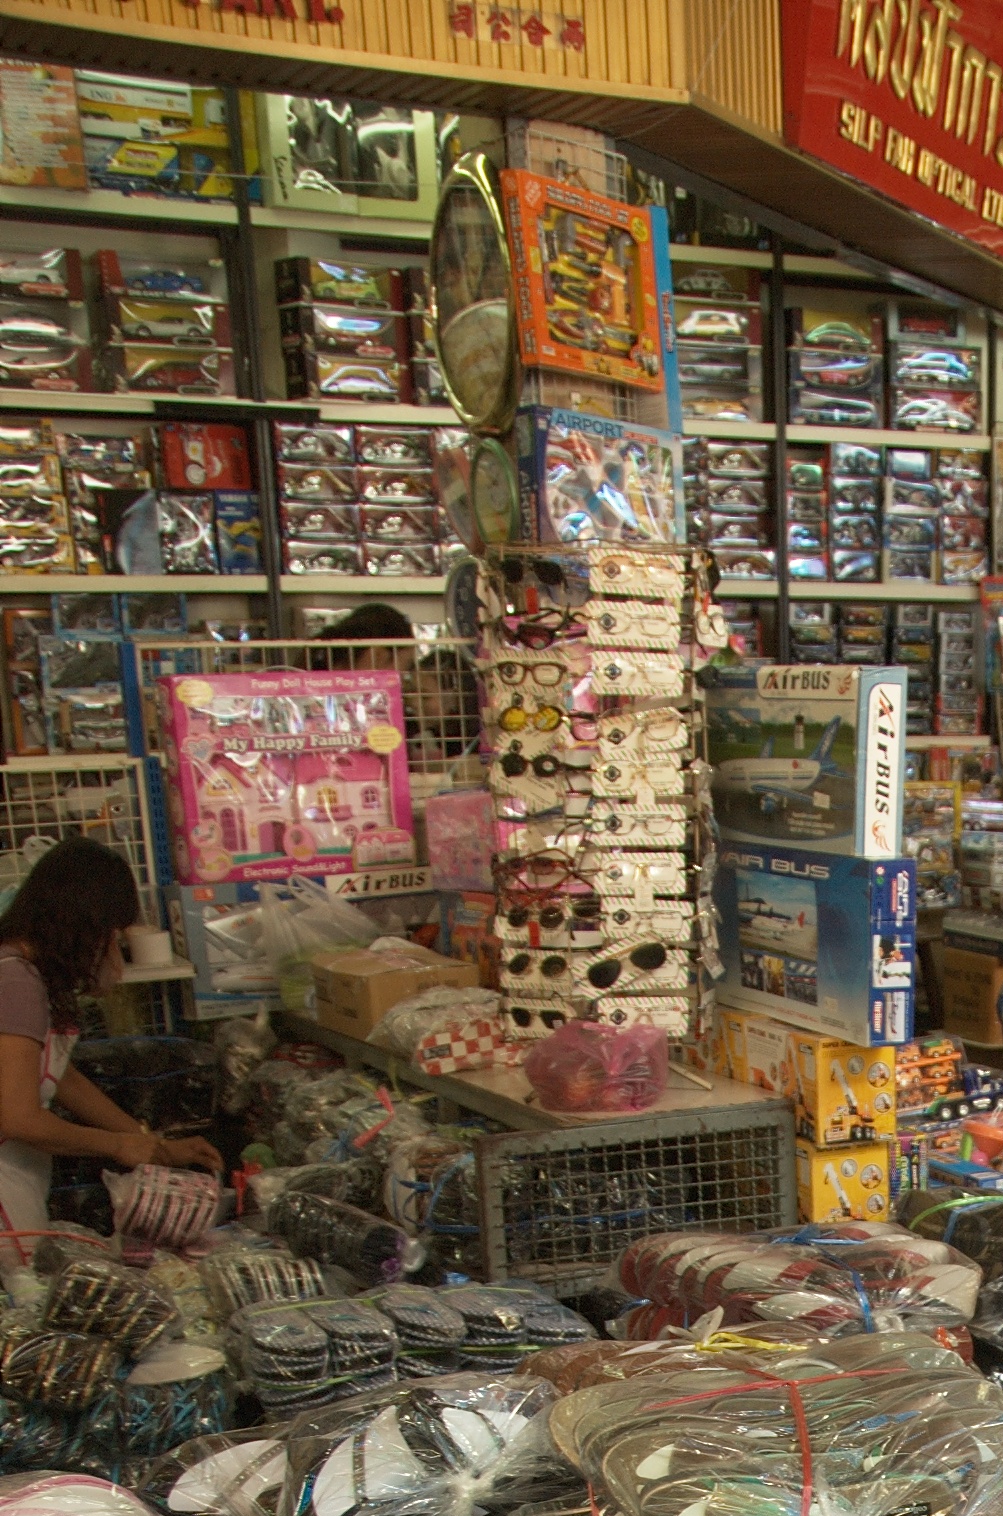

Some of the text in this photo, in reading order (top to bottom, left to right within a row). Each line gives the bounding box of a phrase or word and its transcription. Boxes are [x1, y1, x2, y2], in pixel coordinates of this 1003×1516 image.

[840, 100, 882, 153] SILP
[918, 148, 977, 212] OPTICAL
[556, 412, 624, 438] AIRPORT
[251, 675, 377, 691] Funny Doll House Play Set
[223, 732, 363, 753] My Happy Family
[243, 865, 290, 878] Electronic
[723, 852, 830, 881] AIR BUS
